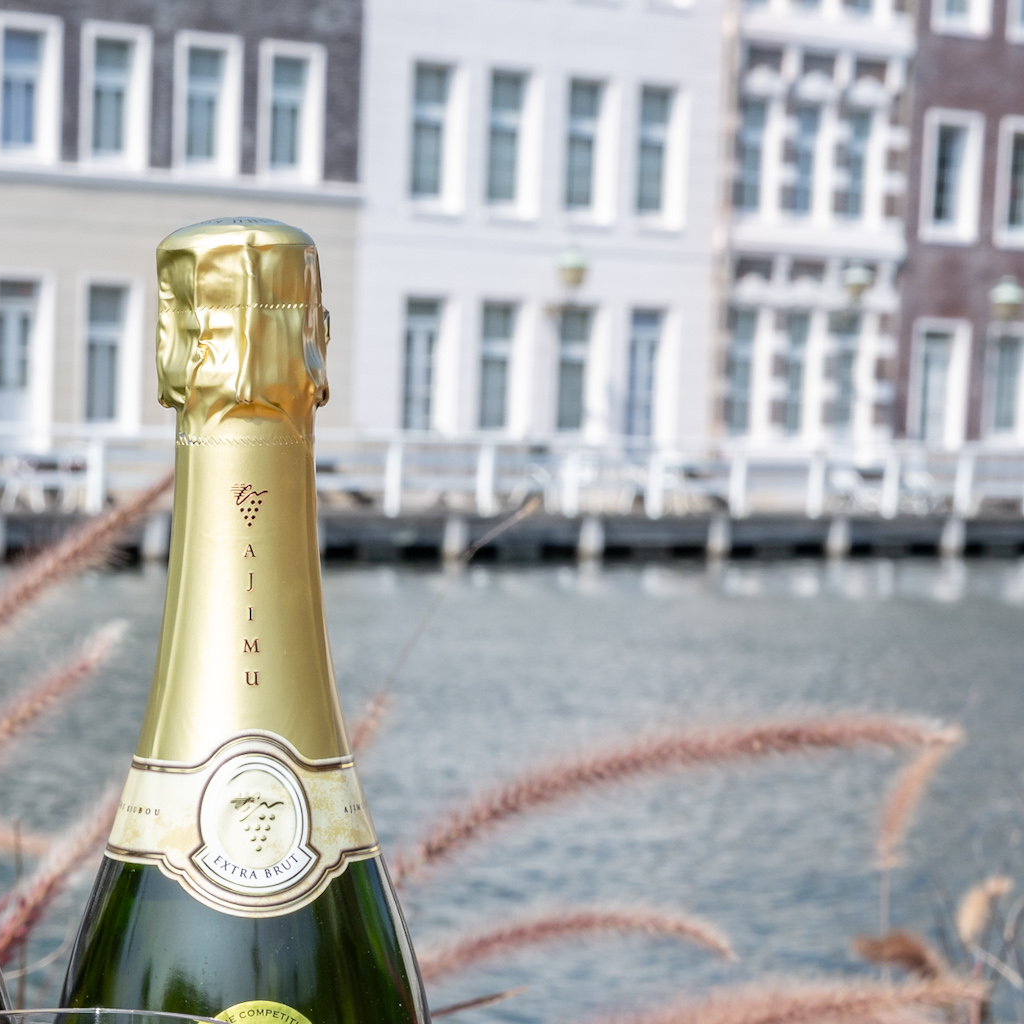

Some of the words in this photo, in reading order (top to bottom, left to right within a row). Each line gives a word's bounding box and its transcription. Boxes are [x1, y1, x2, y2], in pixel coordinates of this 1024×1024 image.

[243, 543, 260, 686] AJIMU
[213, 855, 258, 880] EXTRA
[264, 852, 299, 879] BRUT
